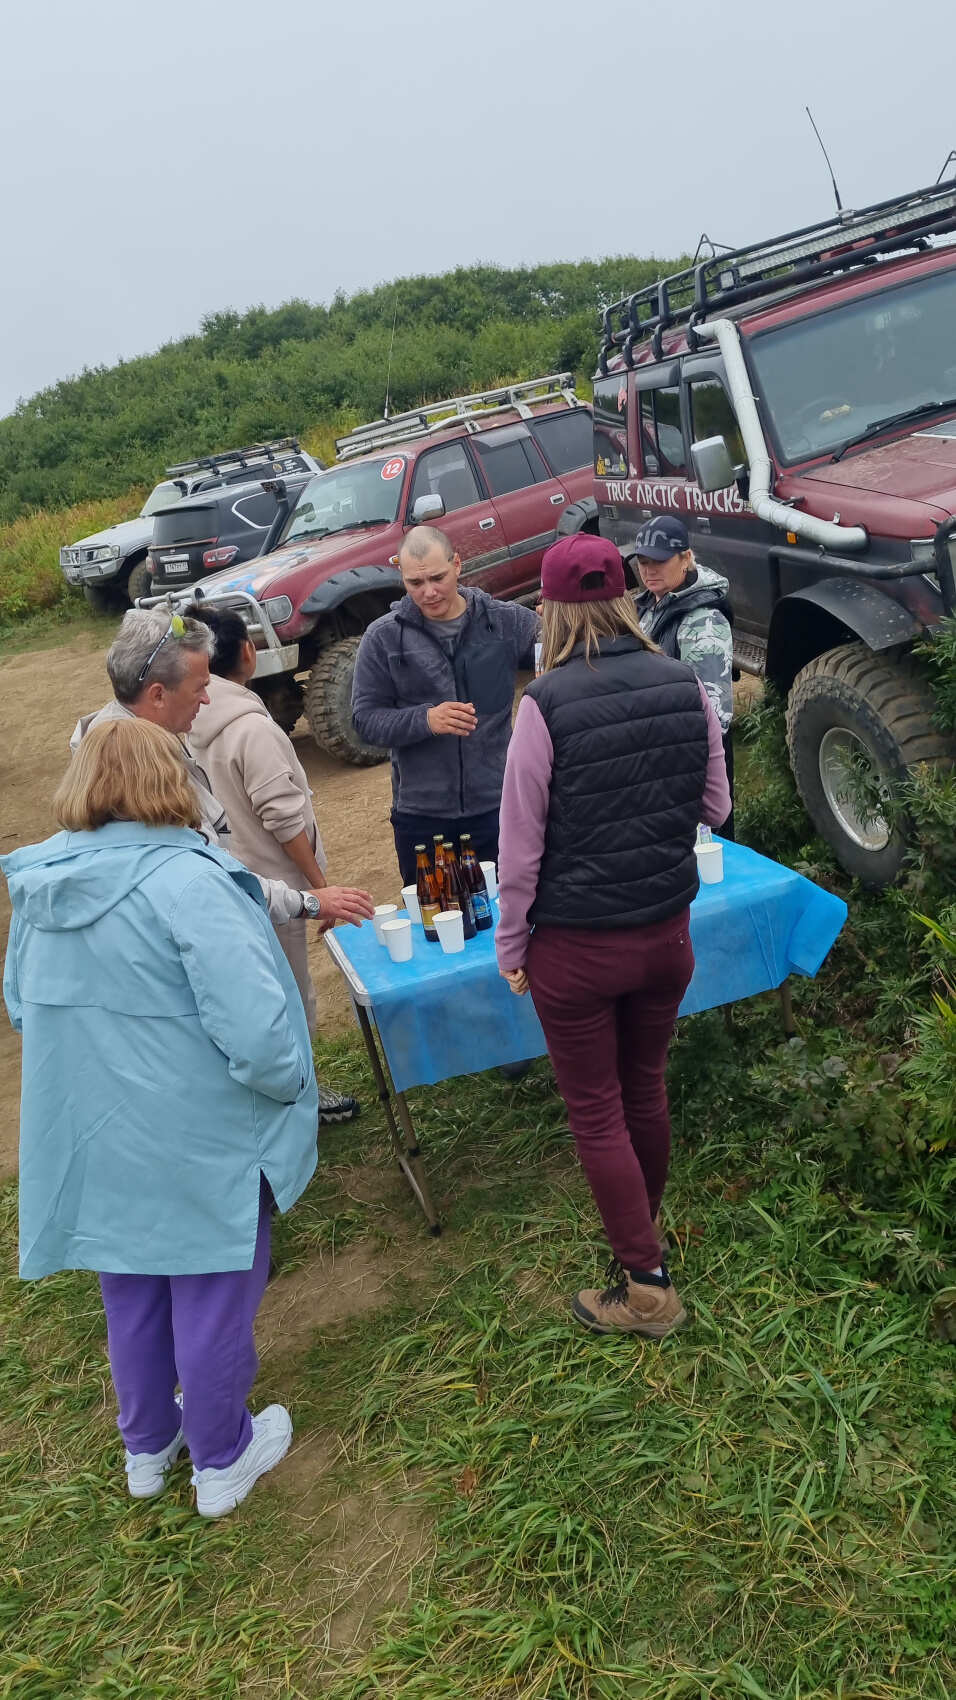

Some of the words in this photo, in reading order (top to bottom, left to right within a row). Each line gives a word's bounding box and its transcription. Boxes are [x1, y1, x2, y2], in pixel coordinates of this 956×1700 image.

[386, 462, 401, 475] 12
[605, 482, 633, 502] TRUE
[636, 483, 680, 509] ARCTIC
[684, 486, 744, 513] TRUCKS
